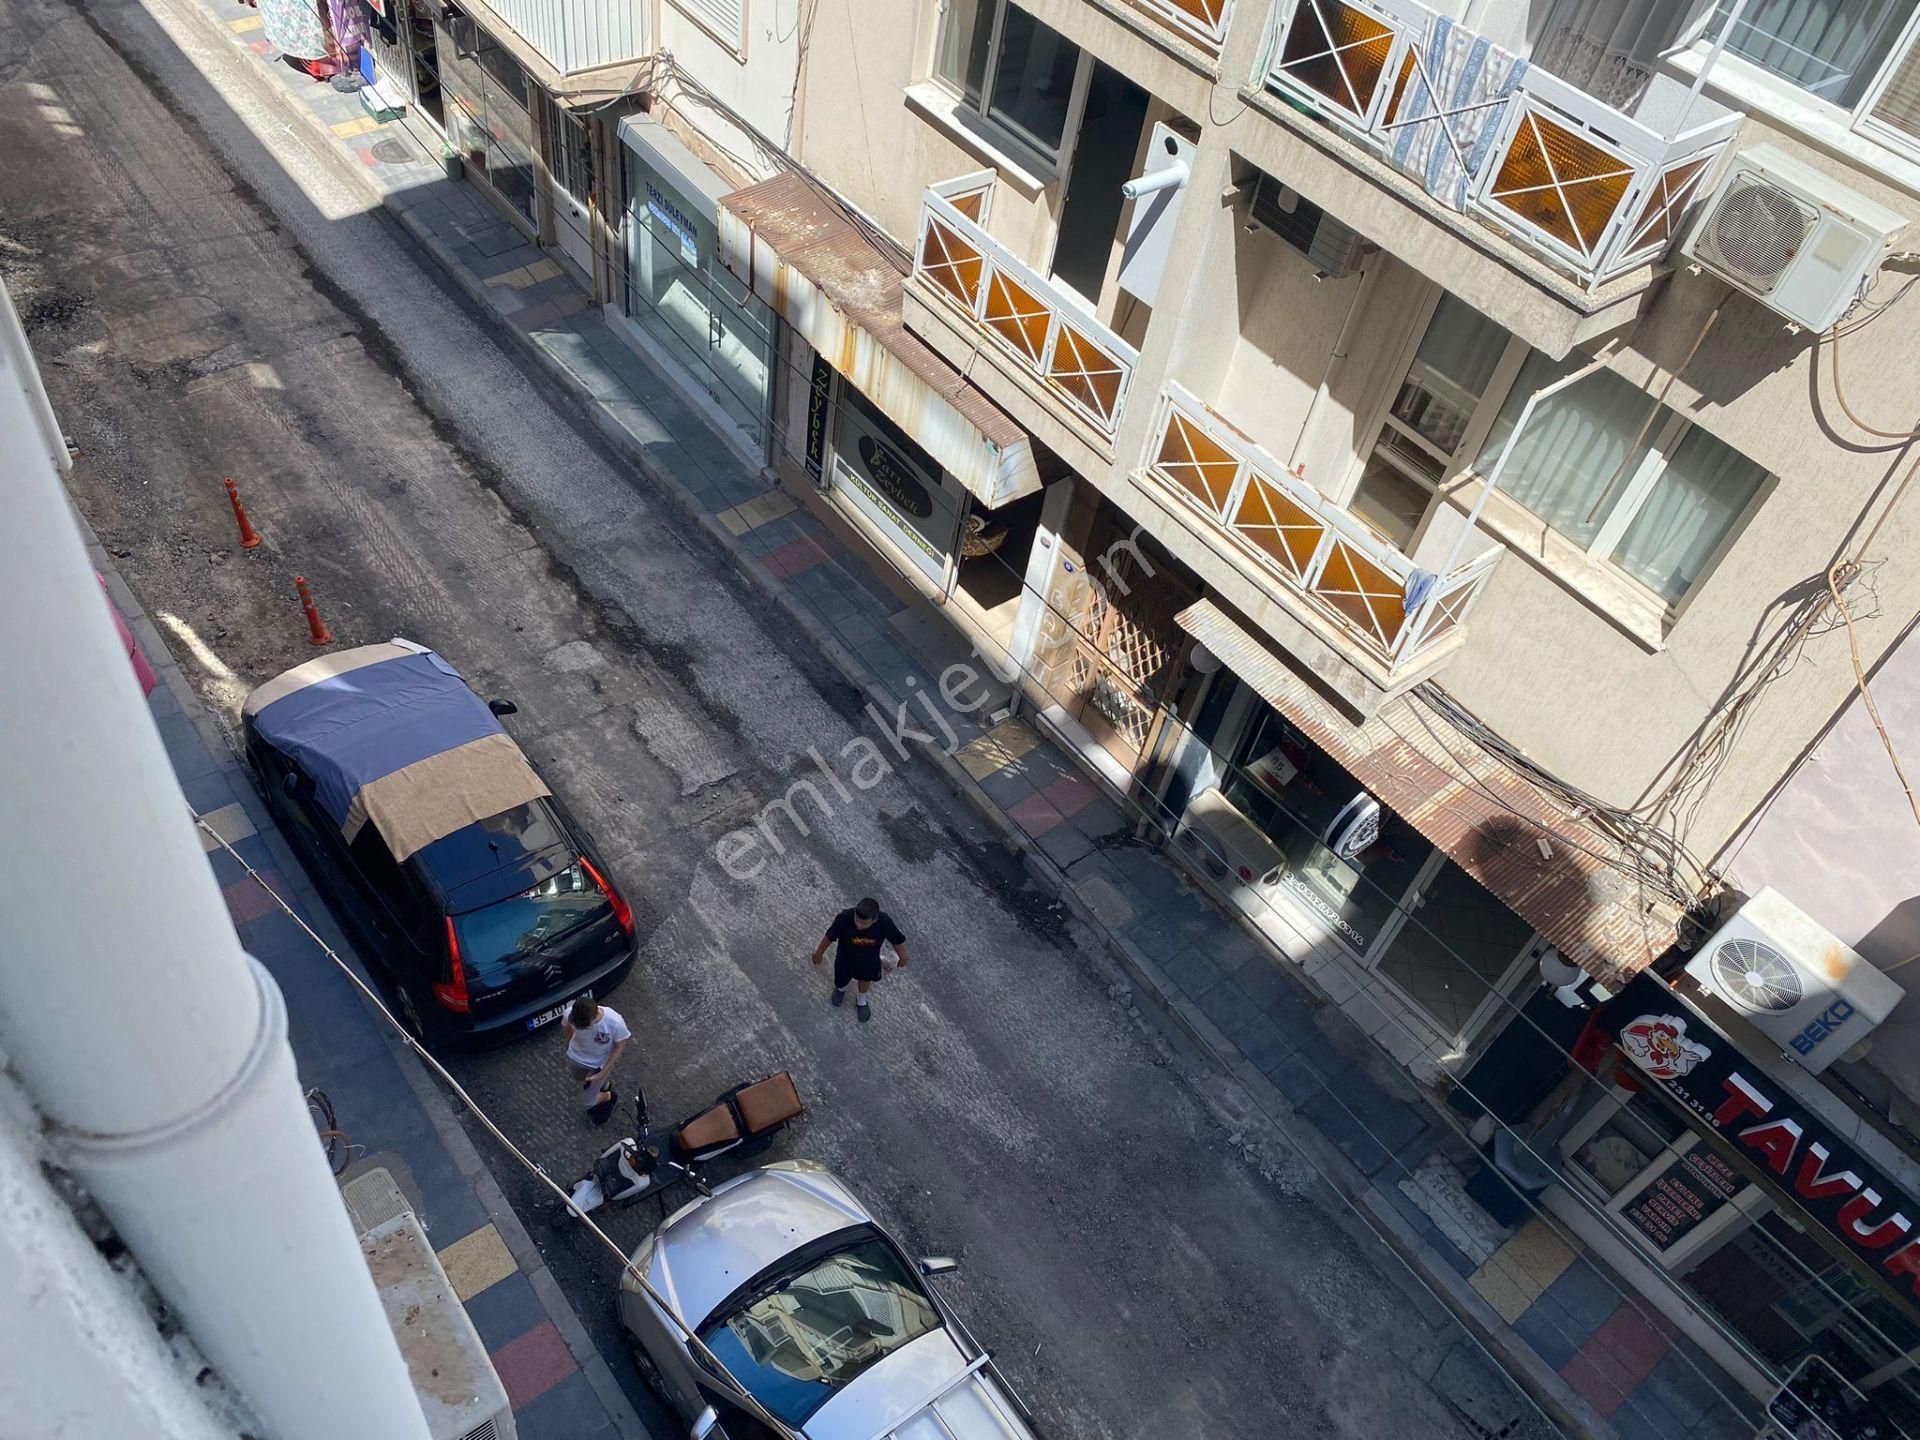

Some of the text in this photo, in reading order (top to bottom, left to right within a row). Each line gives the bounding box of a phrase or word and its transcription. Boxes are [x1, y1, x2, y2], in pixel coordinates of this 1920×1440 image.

[877, 500, 901, 524] SANAT
[1790, 999, 1857, 1056] BEKO
[1668, 1080, 1721, 1128] 231 31 86
